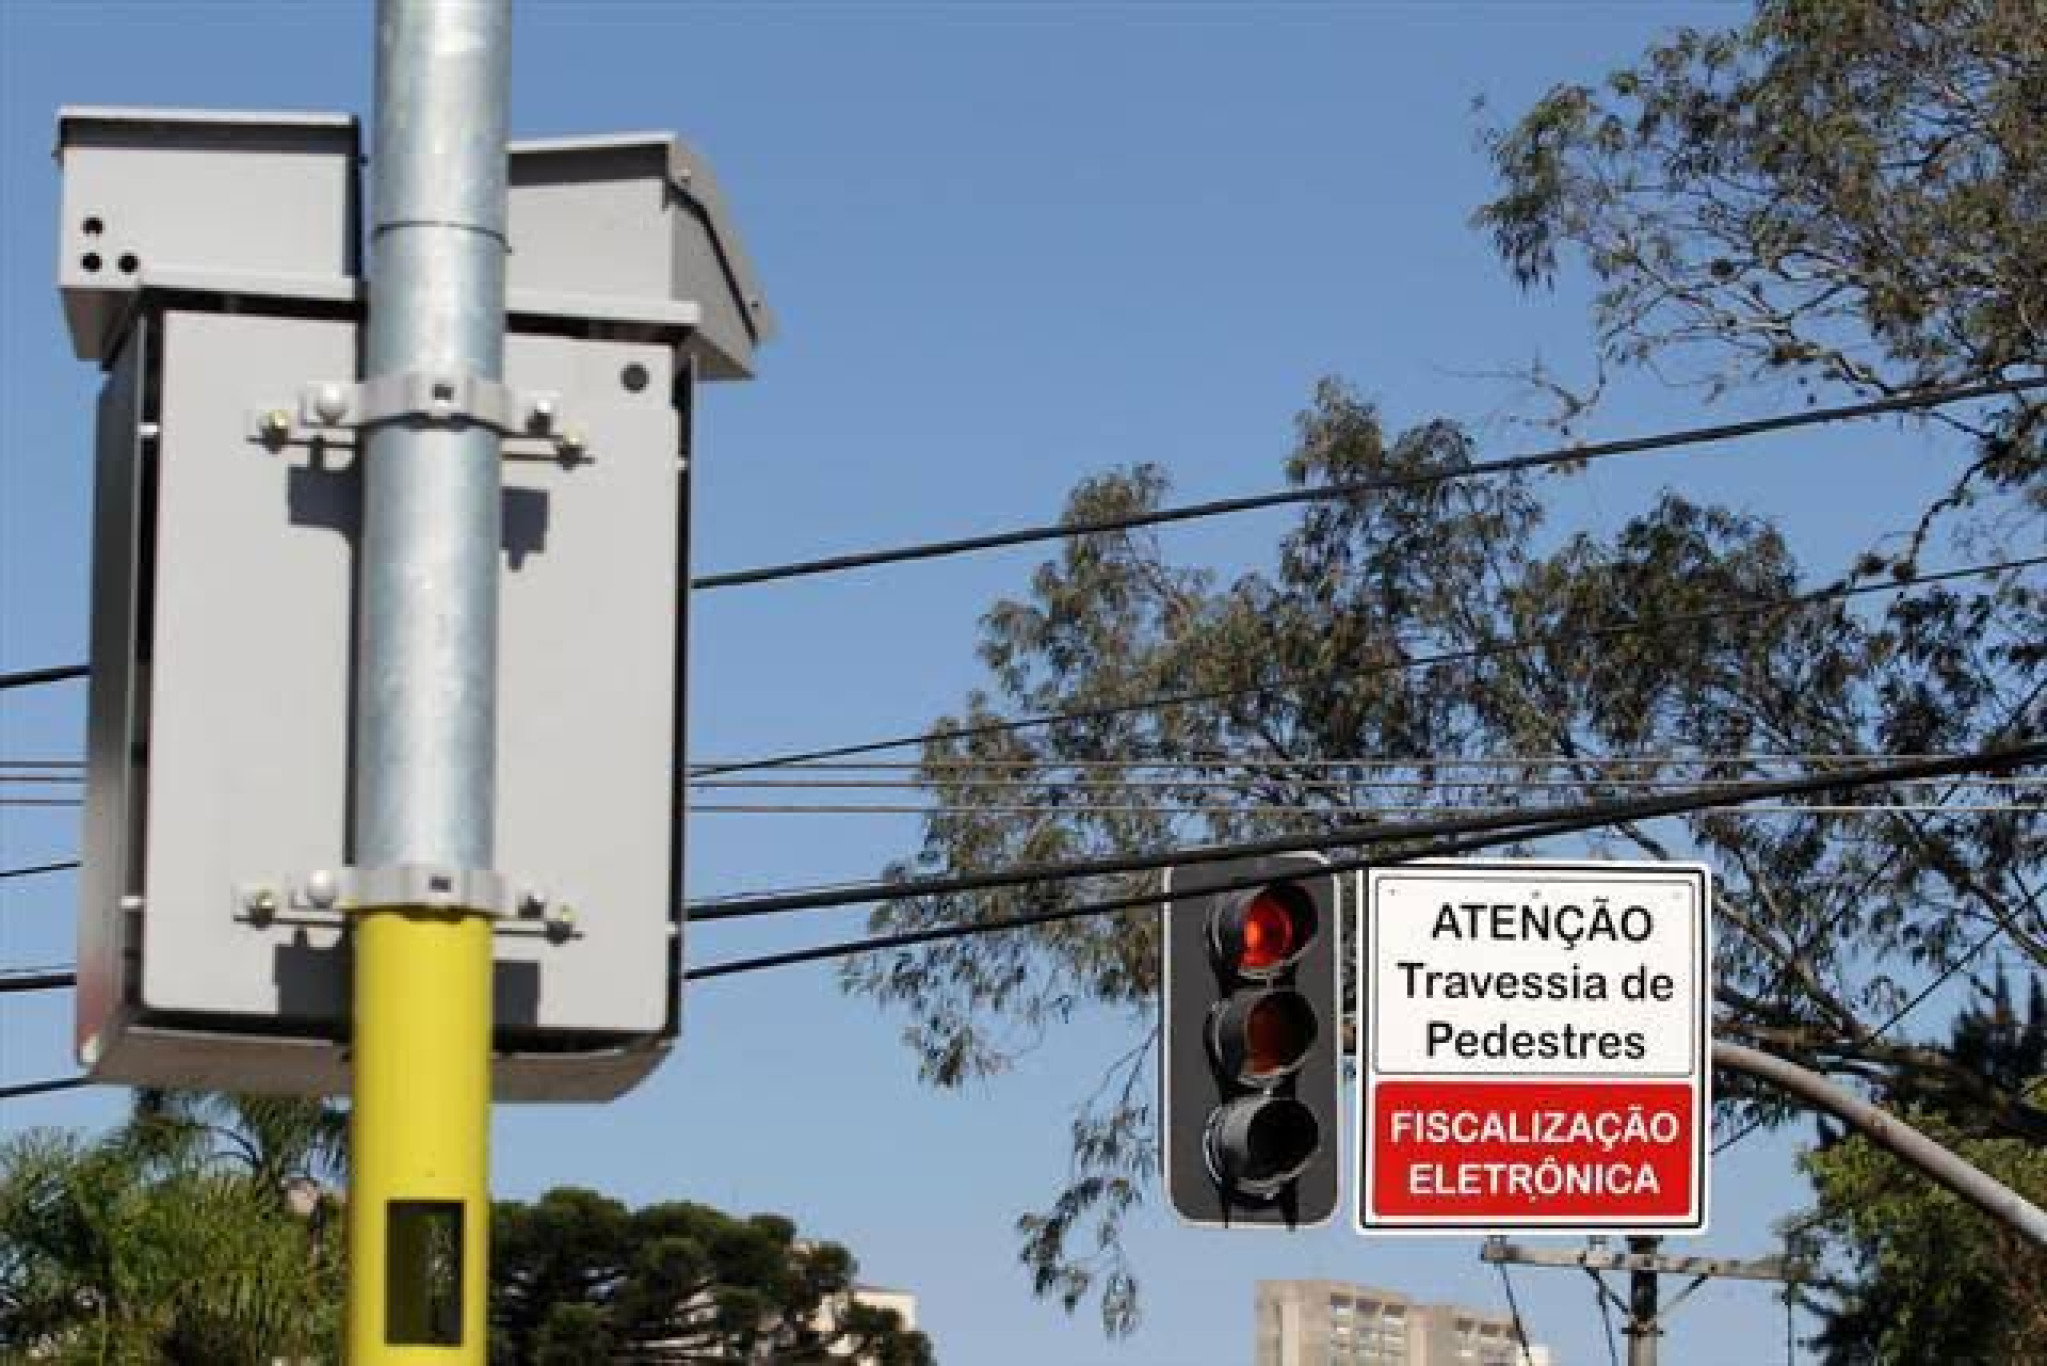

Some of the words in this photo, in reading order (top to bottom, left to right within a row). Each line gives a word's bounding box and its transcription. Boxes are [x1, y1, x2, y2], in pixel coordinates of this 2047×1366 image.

[1432, 897, 1654, 950] ATENÇÃO
[1395, 961, 1607, 1000] Travessia
[1621, 962, 1675, 1001] de
[1426, 1021, 1647, 1060] Pedestres
[1390, 1105, 1680, 1152] FISCALIZAÇÃO
[1408, 1155, 1661, 1195] ELETRÔNICA
